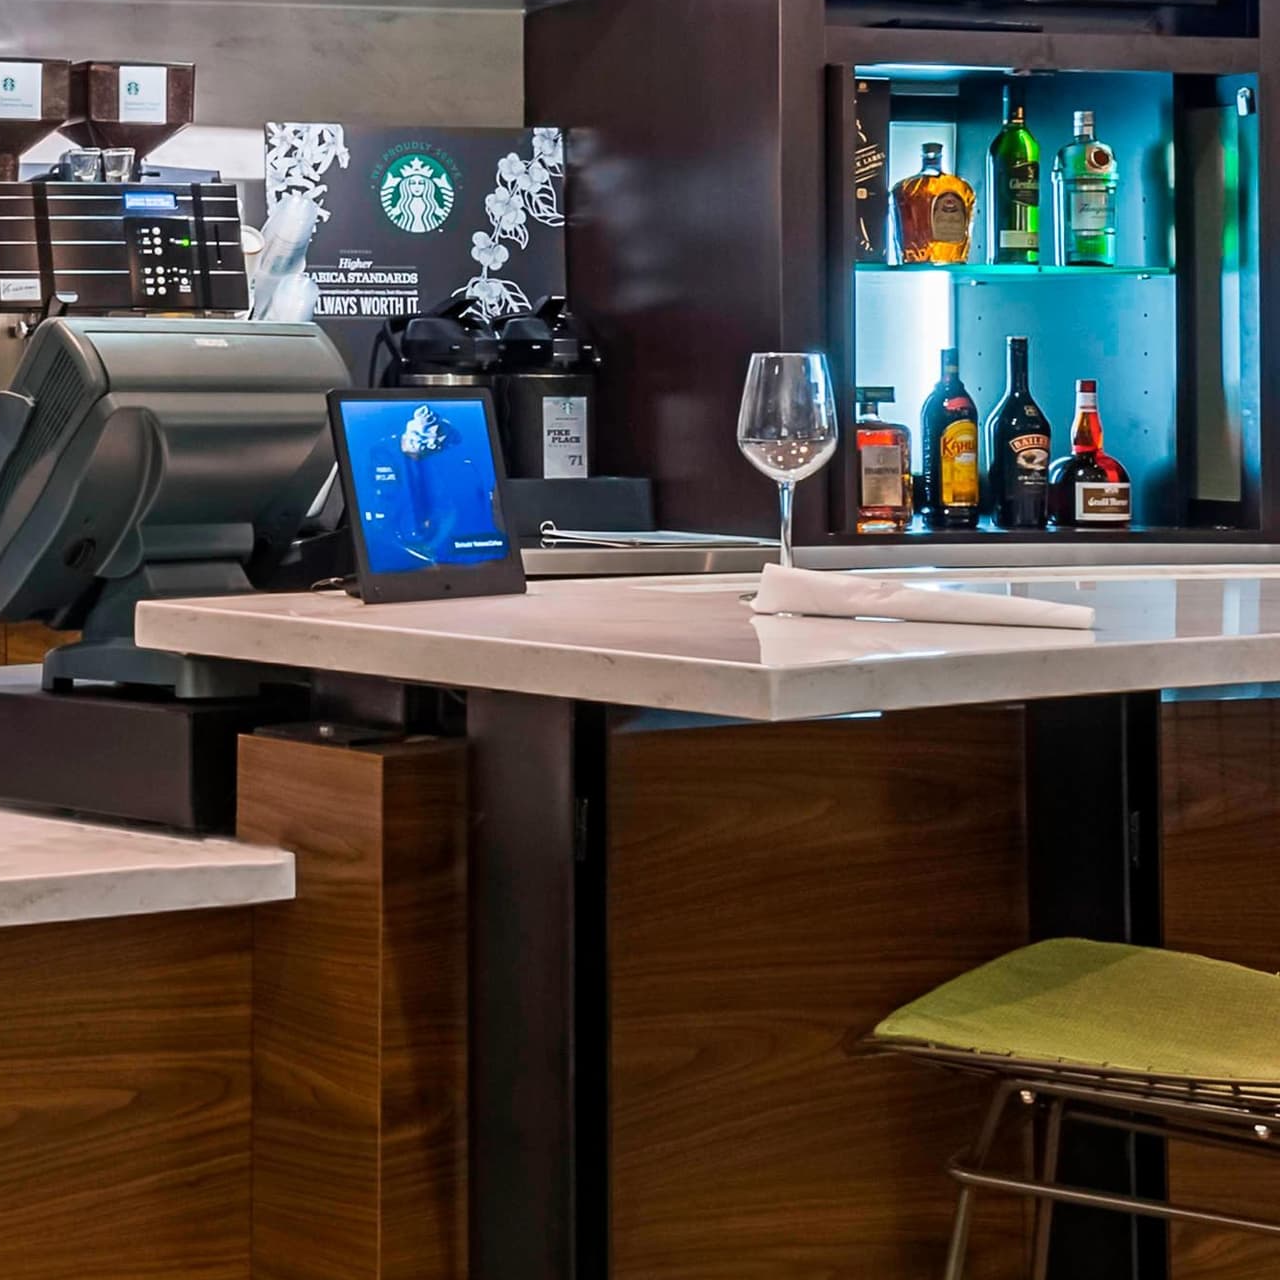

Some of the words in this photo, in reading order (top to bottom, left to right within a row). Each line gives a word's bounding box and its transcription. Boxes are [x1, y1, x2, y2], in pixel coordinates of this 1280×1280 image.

[338, 258, 373, 270] Higher
[347, 272, 418, 284] STANDARDS
[360, 297, 404, 315] WORTH
[407, 297, 421, 314] IT.
[552, 436, 581, 444] PLACE
[568, 455, 583, 466] 71
